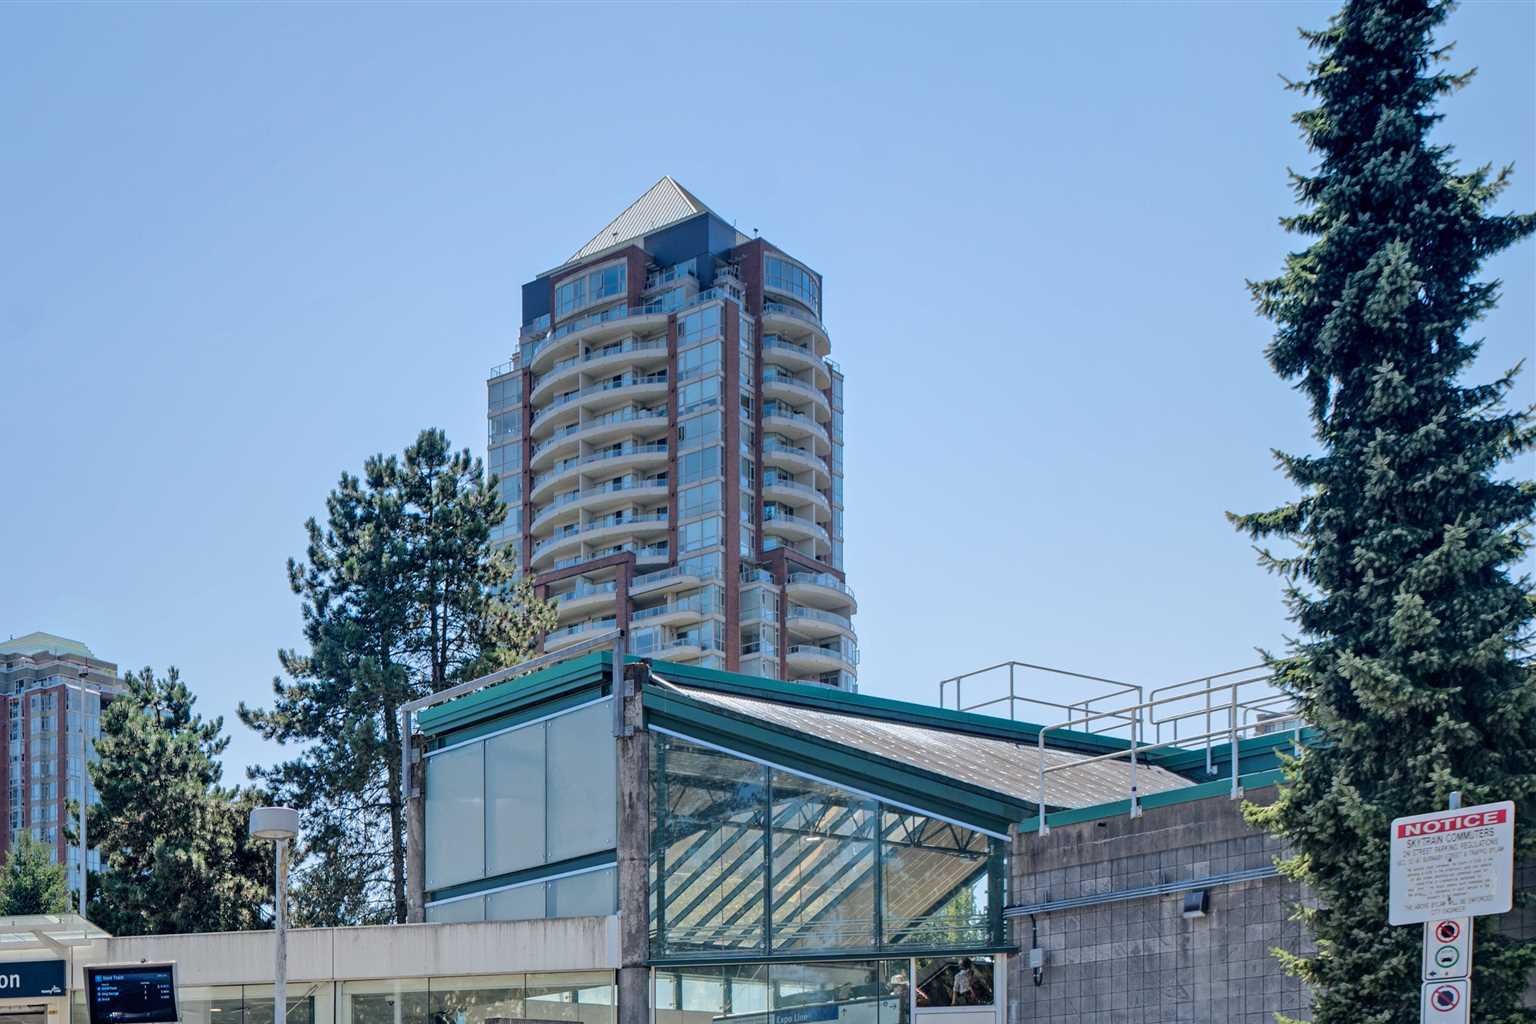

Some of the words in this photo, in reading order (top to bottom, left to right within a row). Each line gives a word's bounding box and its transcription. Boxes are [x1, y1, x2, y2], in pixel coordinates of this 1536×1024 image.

[1405, 811, 1499, 836] NOTICE
[1407, 835, 1443, 849] SKYTRAIN
[1447, 827, 1494, 843] COMMUTERS
[776, 1014, 792, 1024] Expo
[794, 1012, 808, 1022] Line
